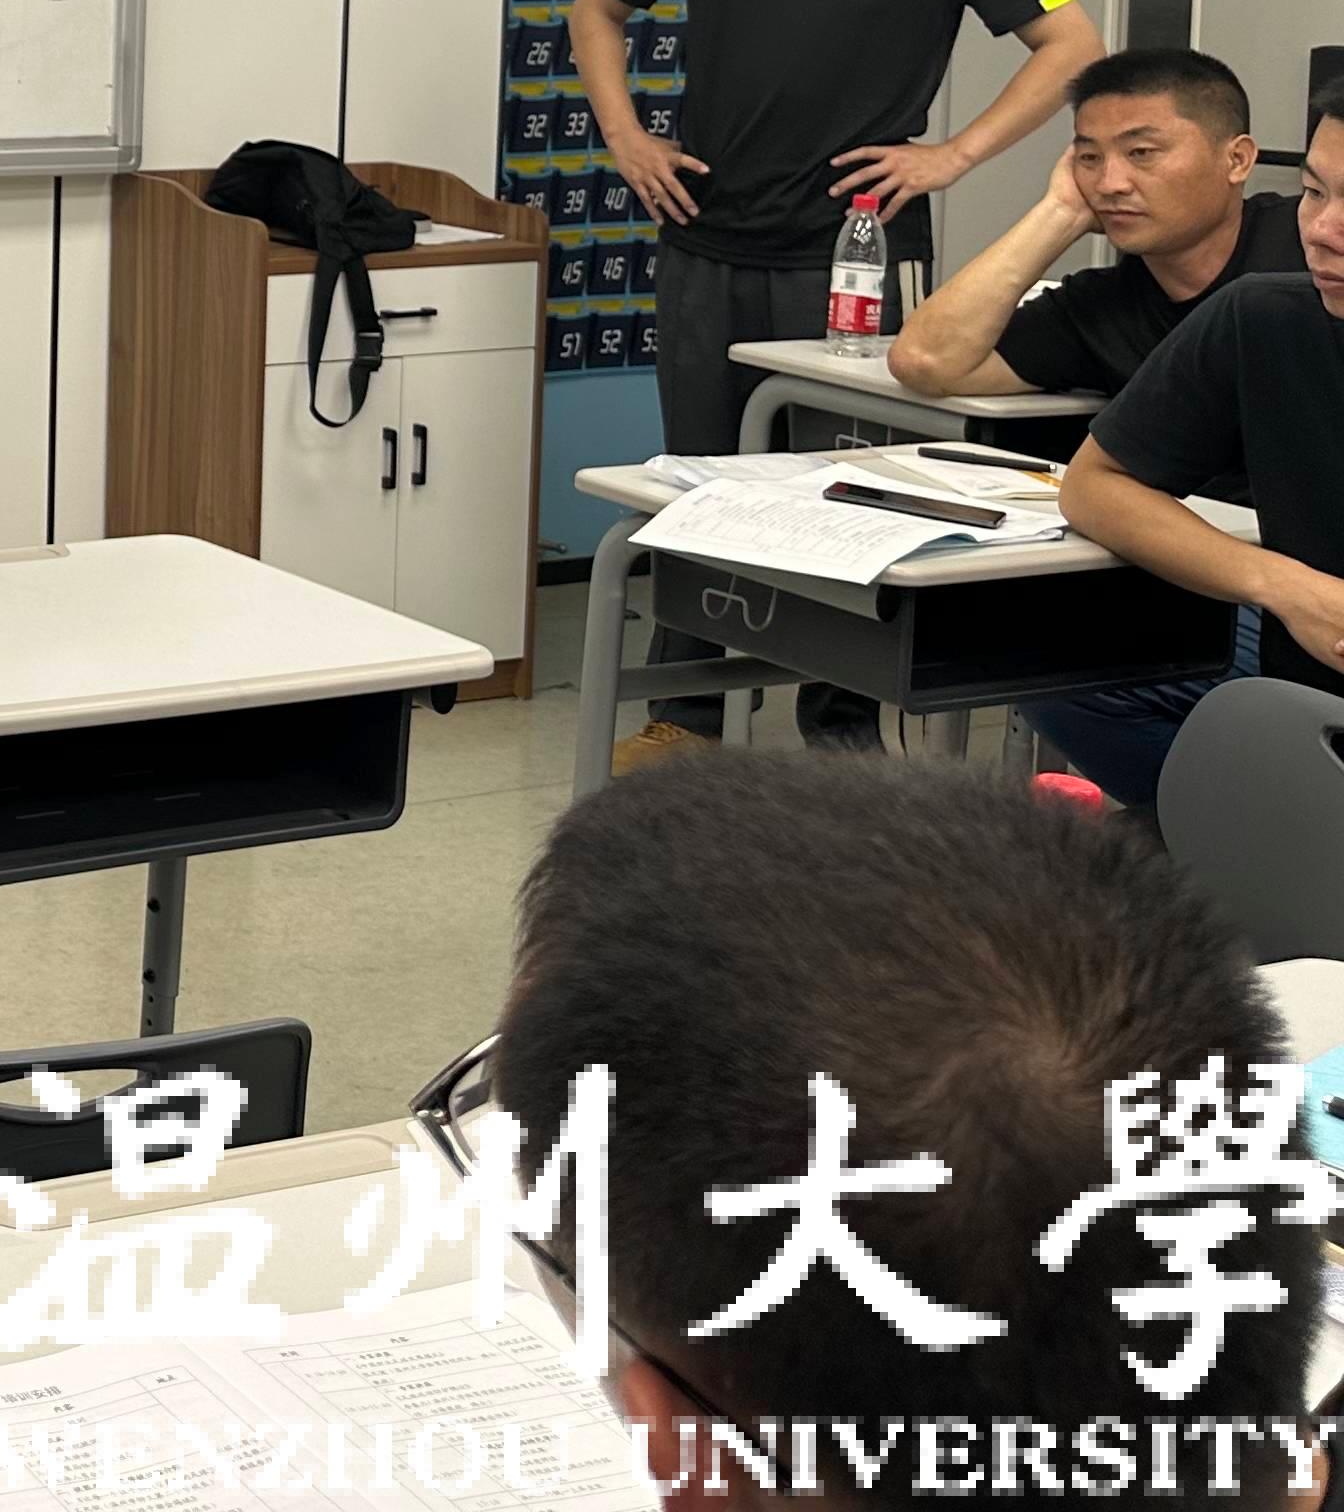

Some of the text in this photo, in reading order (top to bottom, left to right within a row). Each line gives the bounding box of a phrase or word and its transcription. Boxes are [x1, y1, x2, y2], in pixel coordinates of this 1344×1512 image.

[527, 42, 550, 64] 26
[653, 37, 676, 59] 29
[524, 113, 588, 137] 32 33
[649, 111, 671, 133] 35
[565, 190, 585, 212] 39
[605, 188, 627, 209] 40
[563, 257, 655, 282] 45 46 4
[561, 334, 580, 356] 51
[601, 330, 621, 352] 52
